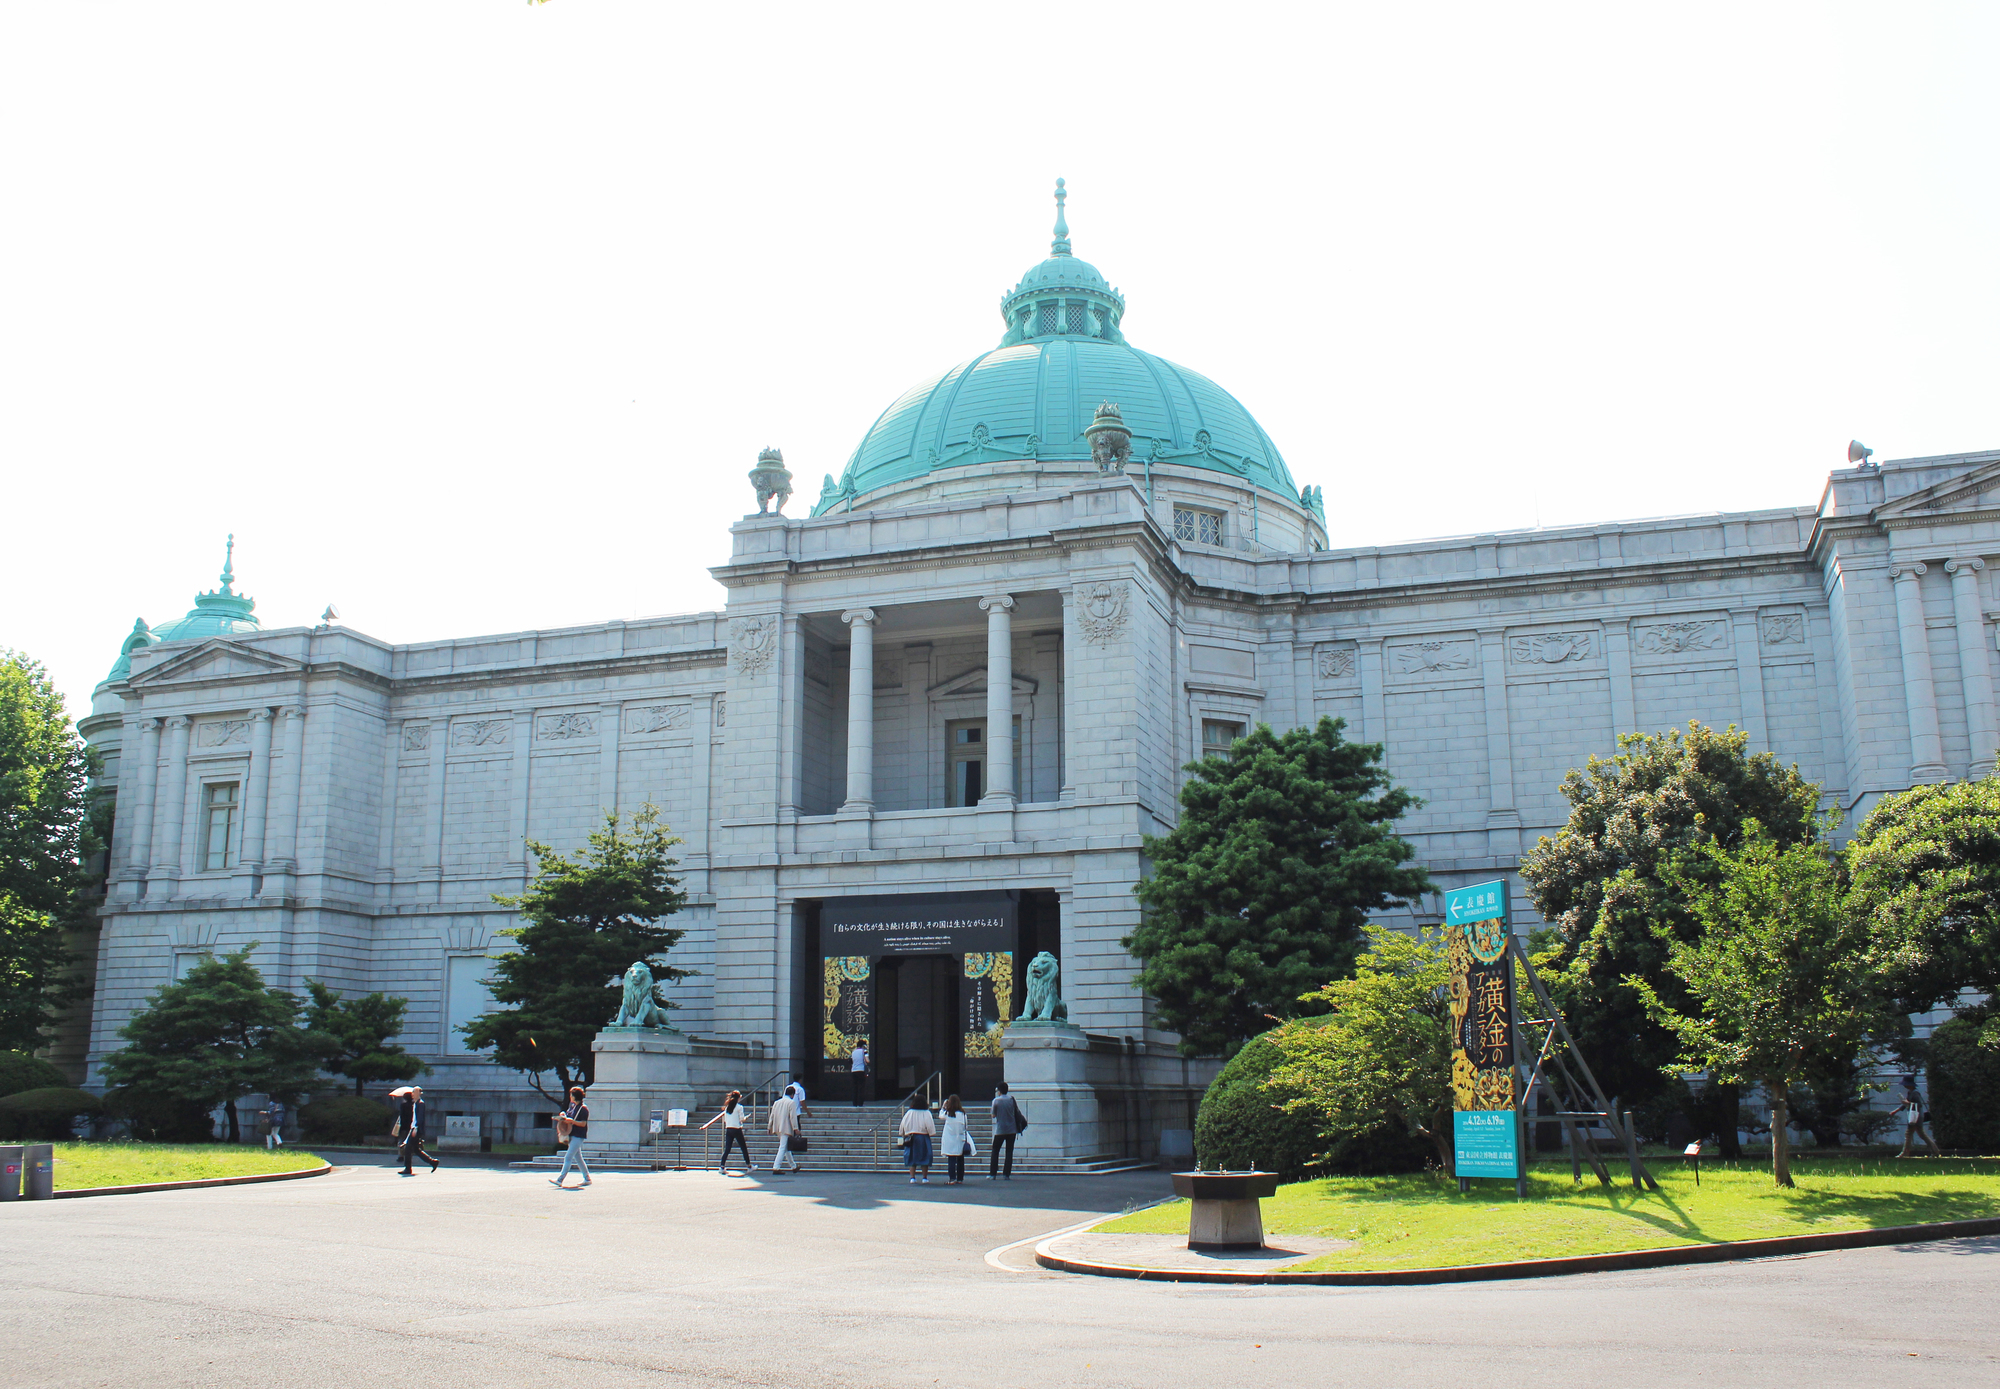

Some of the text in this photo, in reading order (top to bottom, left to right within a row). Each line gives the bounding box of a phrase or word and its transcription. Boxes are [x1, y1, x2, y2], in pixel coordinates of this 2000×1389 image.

[1467, 892, 1495, 908] 表慶館
[853, 989, 869, 1032] 黄金の
[1475, 972, 1487, 1064] アフガニスタン
[1485, 977, 1508, 1063] 黄金の
